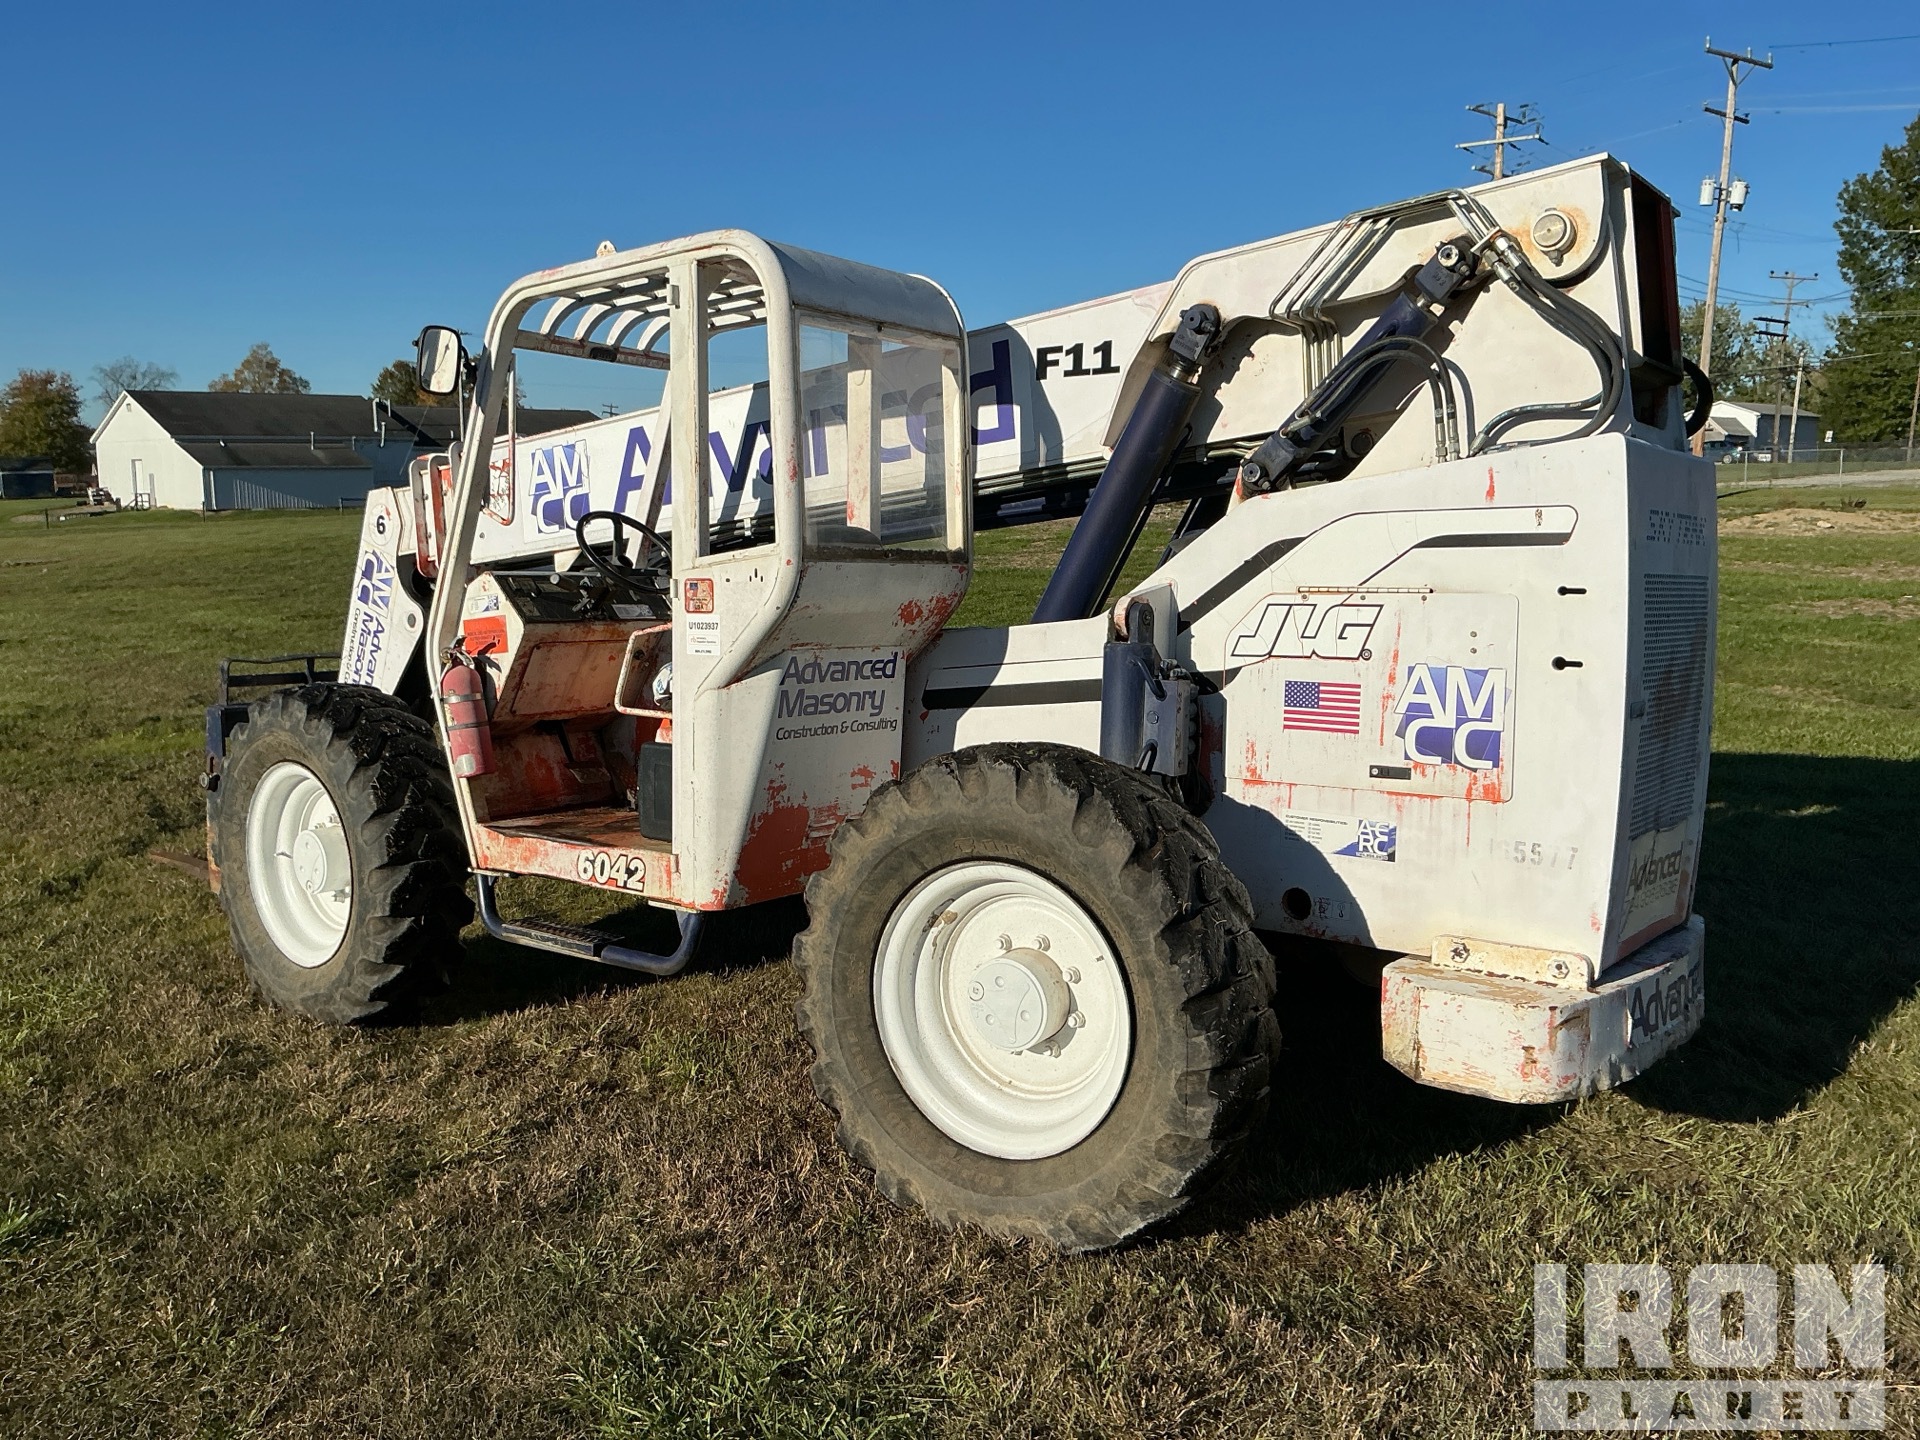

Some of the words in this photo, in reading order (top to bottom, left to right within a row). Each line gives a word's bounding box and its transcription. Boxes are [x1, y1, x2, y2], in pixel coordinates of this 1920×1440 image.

[1035, 340, 1120, 380] F11
[376, 515, 386, 535] 6
[689, 621, 719, 631] U1023937
[1231, 603, 1384, 660] JLG
[779, 652, 898, 686] Advanced
[778, 688, 885, 718] Masonry
[776, 723, 839, 741] Construction
[840, 720, 849, 733] &
[850, 718, 898, 733] Consulting
[577, 850, 646, 892] 6042
[1626, 841, 1683, 896] Advanced
